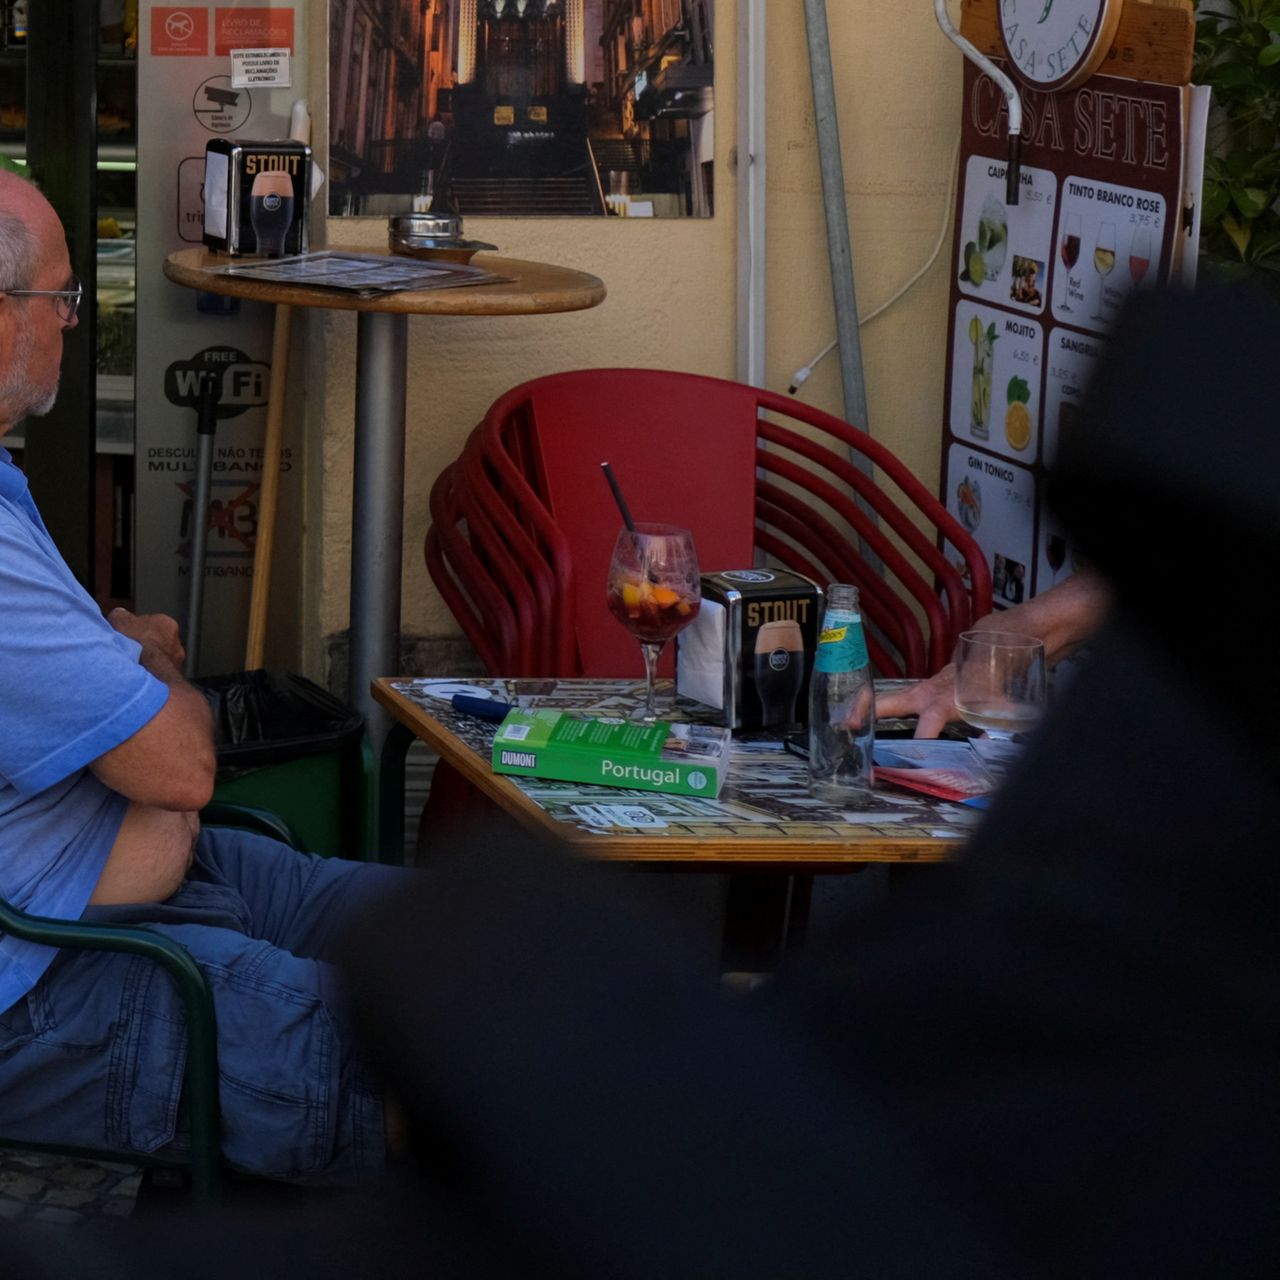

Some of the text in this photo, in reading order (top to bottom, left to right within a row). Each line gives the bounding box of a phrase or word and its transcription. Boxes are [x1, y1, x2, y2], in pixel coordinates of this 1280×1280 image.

[1073, 88, 1169, 171] SETE
[246, 155, 301, 175] STOUT
[1069, 183, 1161, 214] TINTO BRANCO ROSE
[1005, 320, 1036, 339] MOJITO
[204, 352, 238, 361] FREE
[218, 447, 246, 458] NÃO
[968, 455, 1014, 483] GIN TONICO
[748, 599, 811, 627] STOUT
[501, 750, 680, 786] DUMONT Portugal
